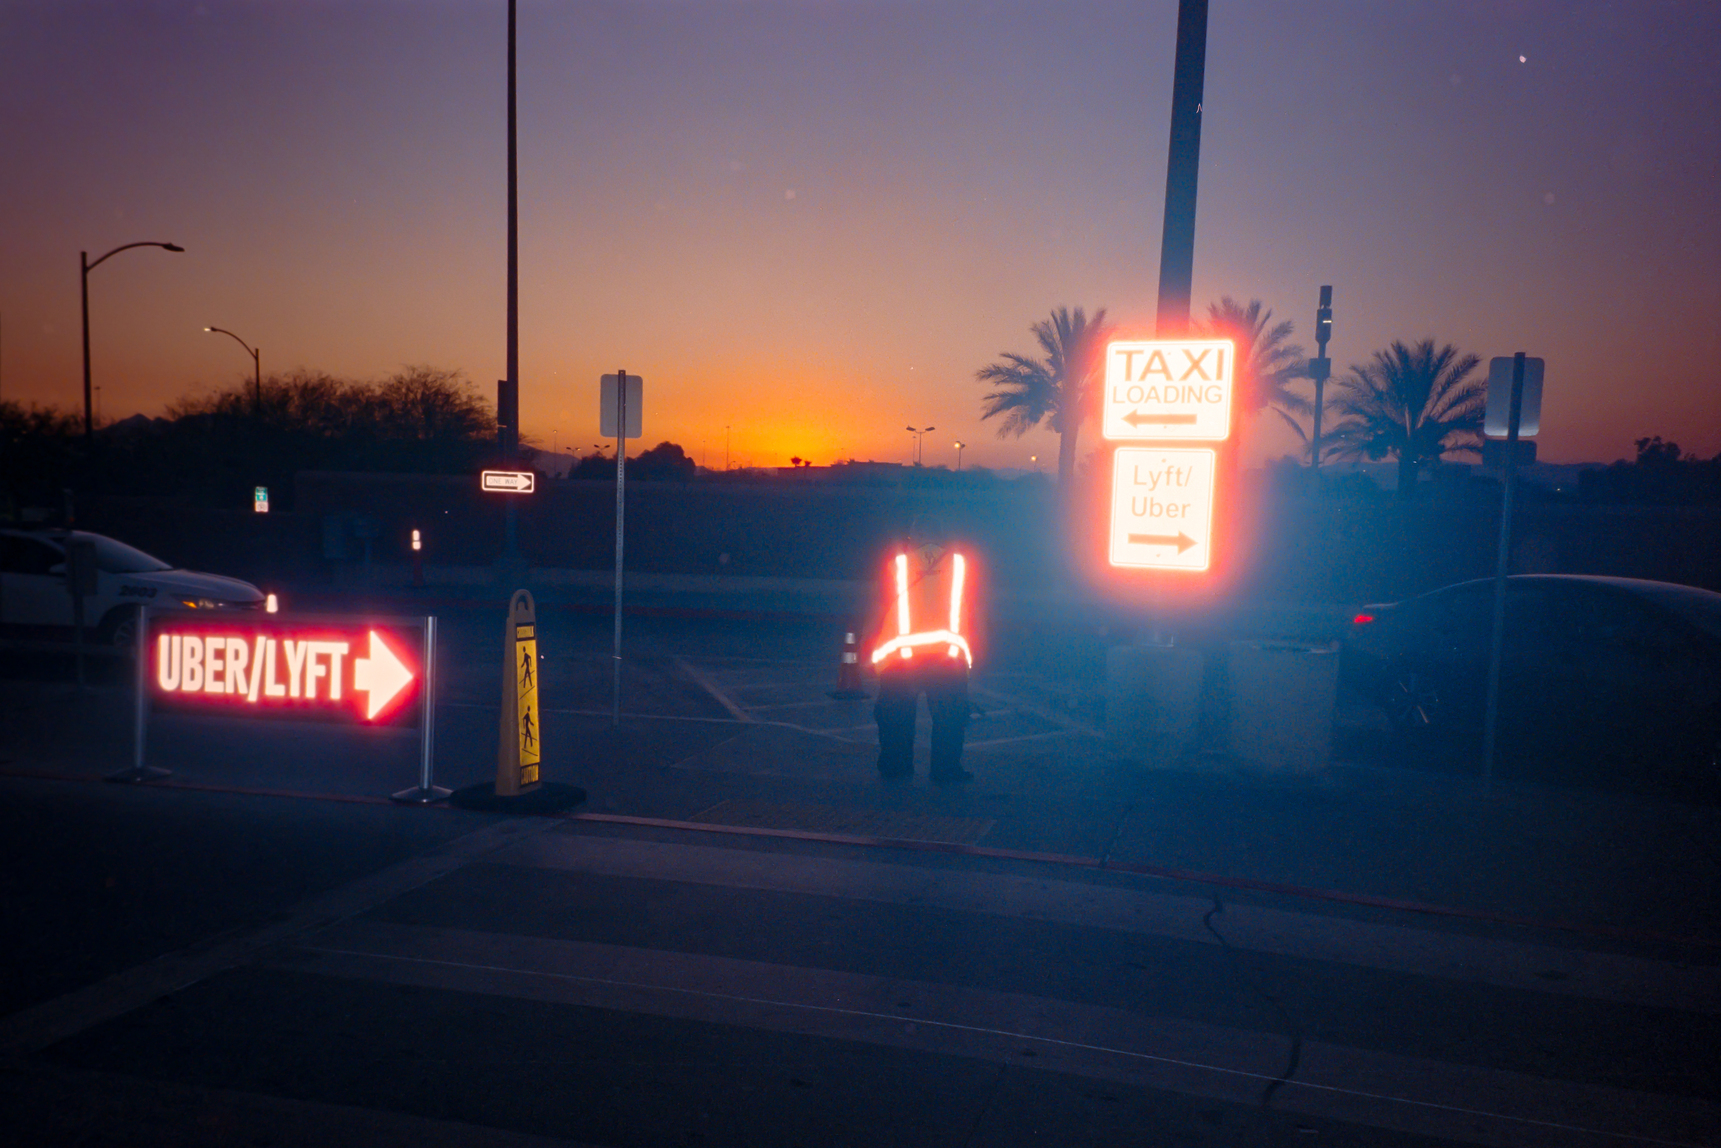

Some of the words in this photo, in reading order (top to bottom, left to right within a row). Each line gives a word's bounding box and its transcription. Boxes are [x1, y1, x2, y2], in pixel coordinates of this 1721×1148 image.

[1115, 349, 1224, 381] TAXI
[1112, 386, 1222, 404] LOADING
[1133, 464, 1193, 491] Lyft/
[1131, 496, 1191, 518] Uber
[158, 634, 349, 702] UBER/LYFT
